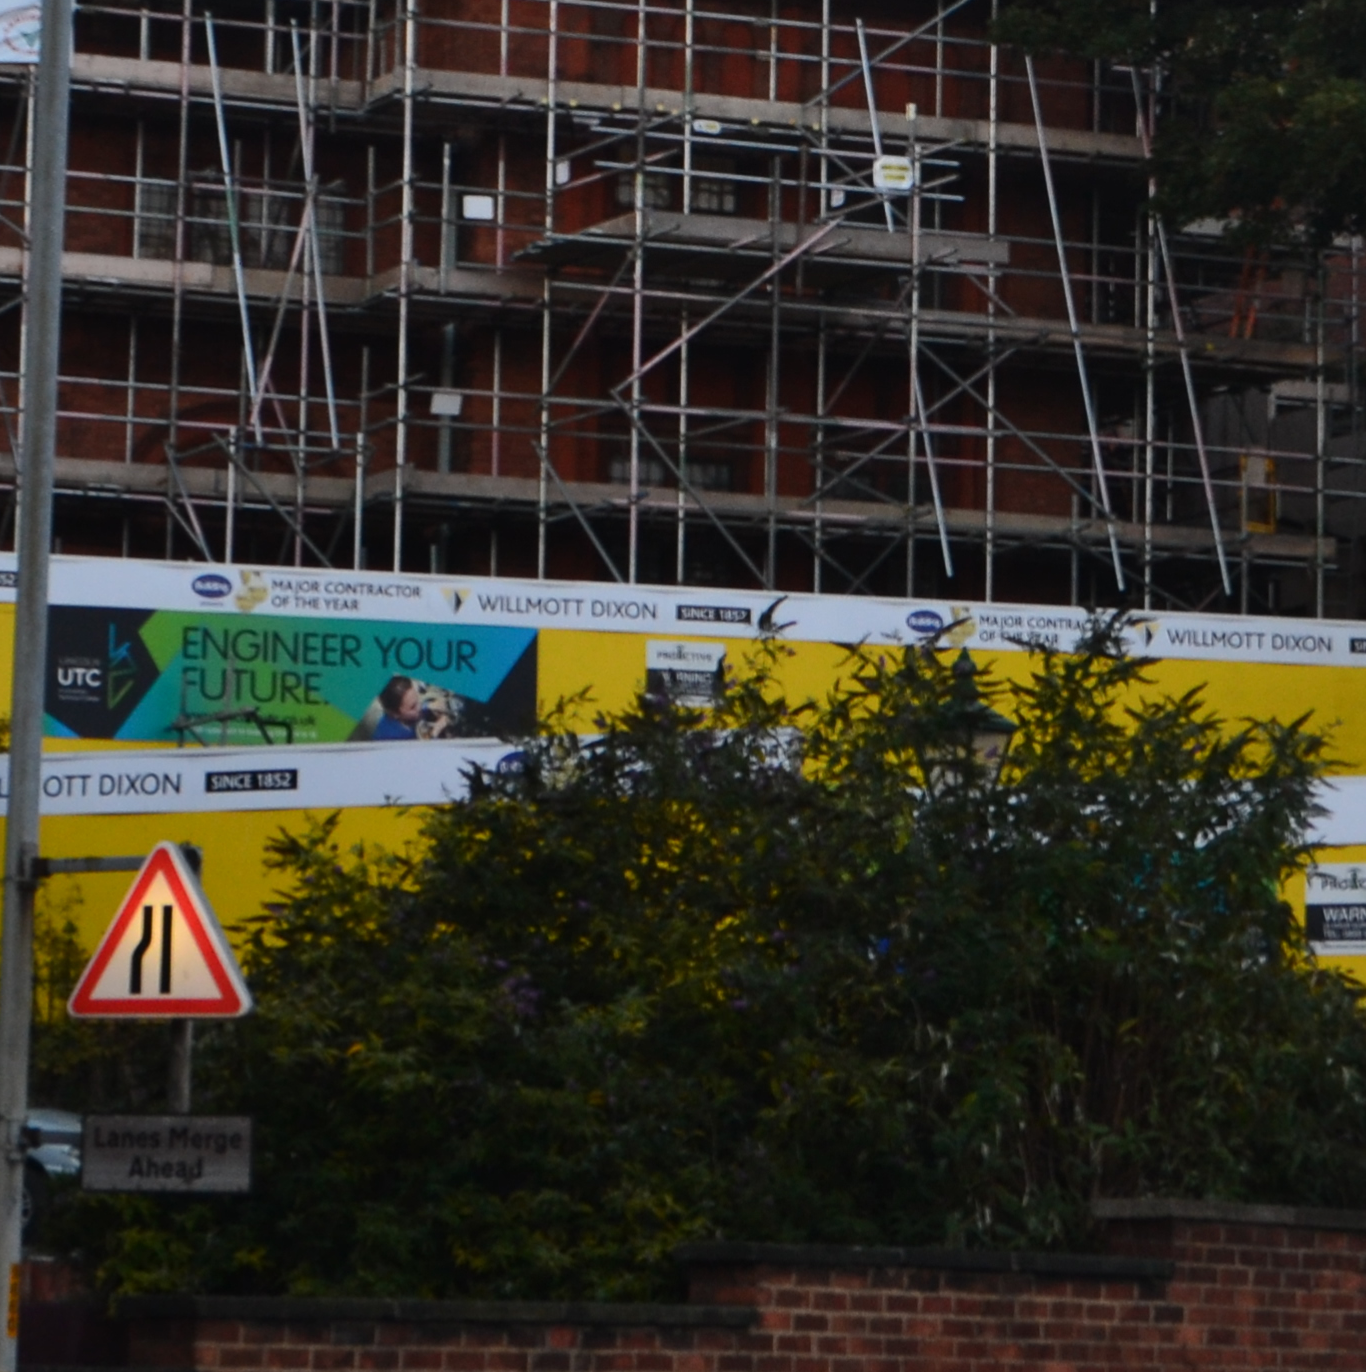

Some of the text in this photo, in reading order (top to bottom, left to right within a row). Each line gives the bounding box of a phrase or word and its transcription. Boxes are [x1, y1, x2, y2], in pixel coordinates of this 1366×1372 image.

[271, 579, 422, 598] MAJOR CONTRACTOR
[271, 595, 359, 611] OF THE YEAR
[478, 594, 584, 618] WILLMOTT
[591, 601, 657, 620] DIXON
[680, 608, 715, 621] SINCE
[979, 614, 1023, 630] MAJOR
[979, 630, 998, 642] OF
[1167, 628, 1266, 649] WILLMOTT
[1271, 634, 1333, 652] DIXON
[182, 627, 478, 673] ENGINEER YOUR
[57, 667, 102, 688] UTC
[182, 666, 329, 706] FUTURE.
[98, 773, 181, 797] DIXON
[210, 772, 252, 790] SINCE
[256, 770, 292, 789] 1852
[93, 1127, 242, 1154] Lanes Merge
[129, 1155, 203, 1178] Ahead
